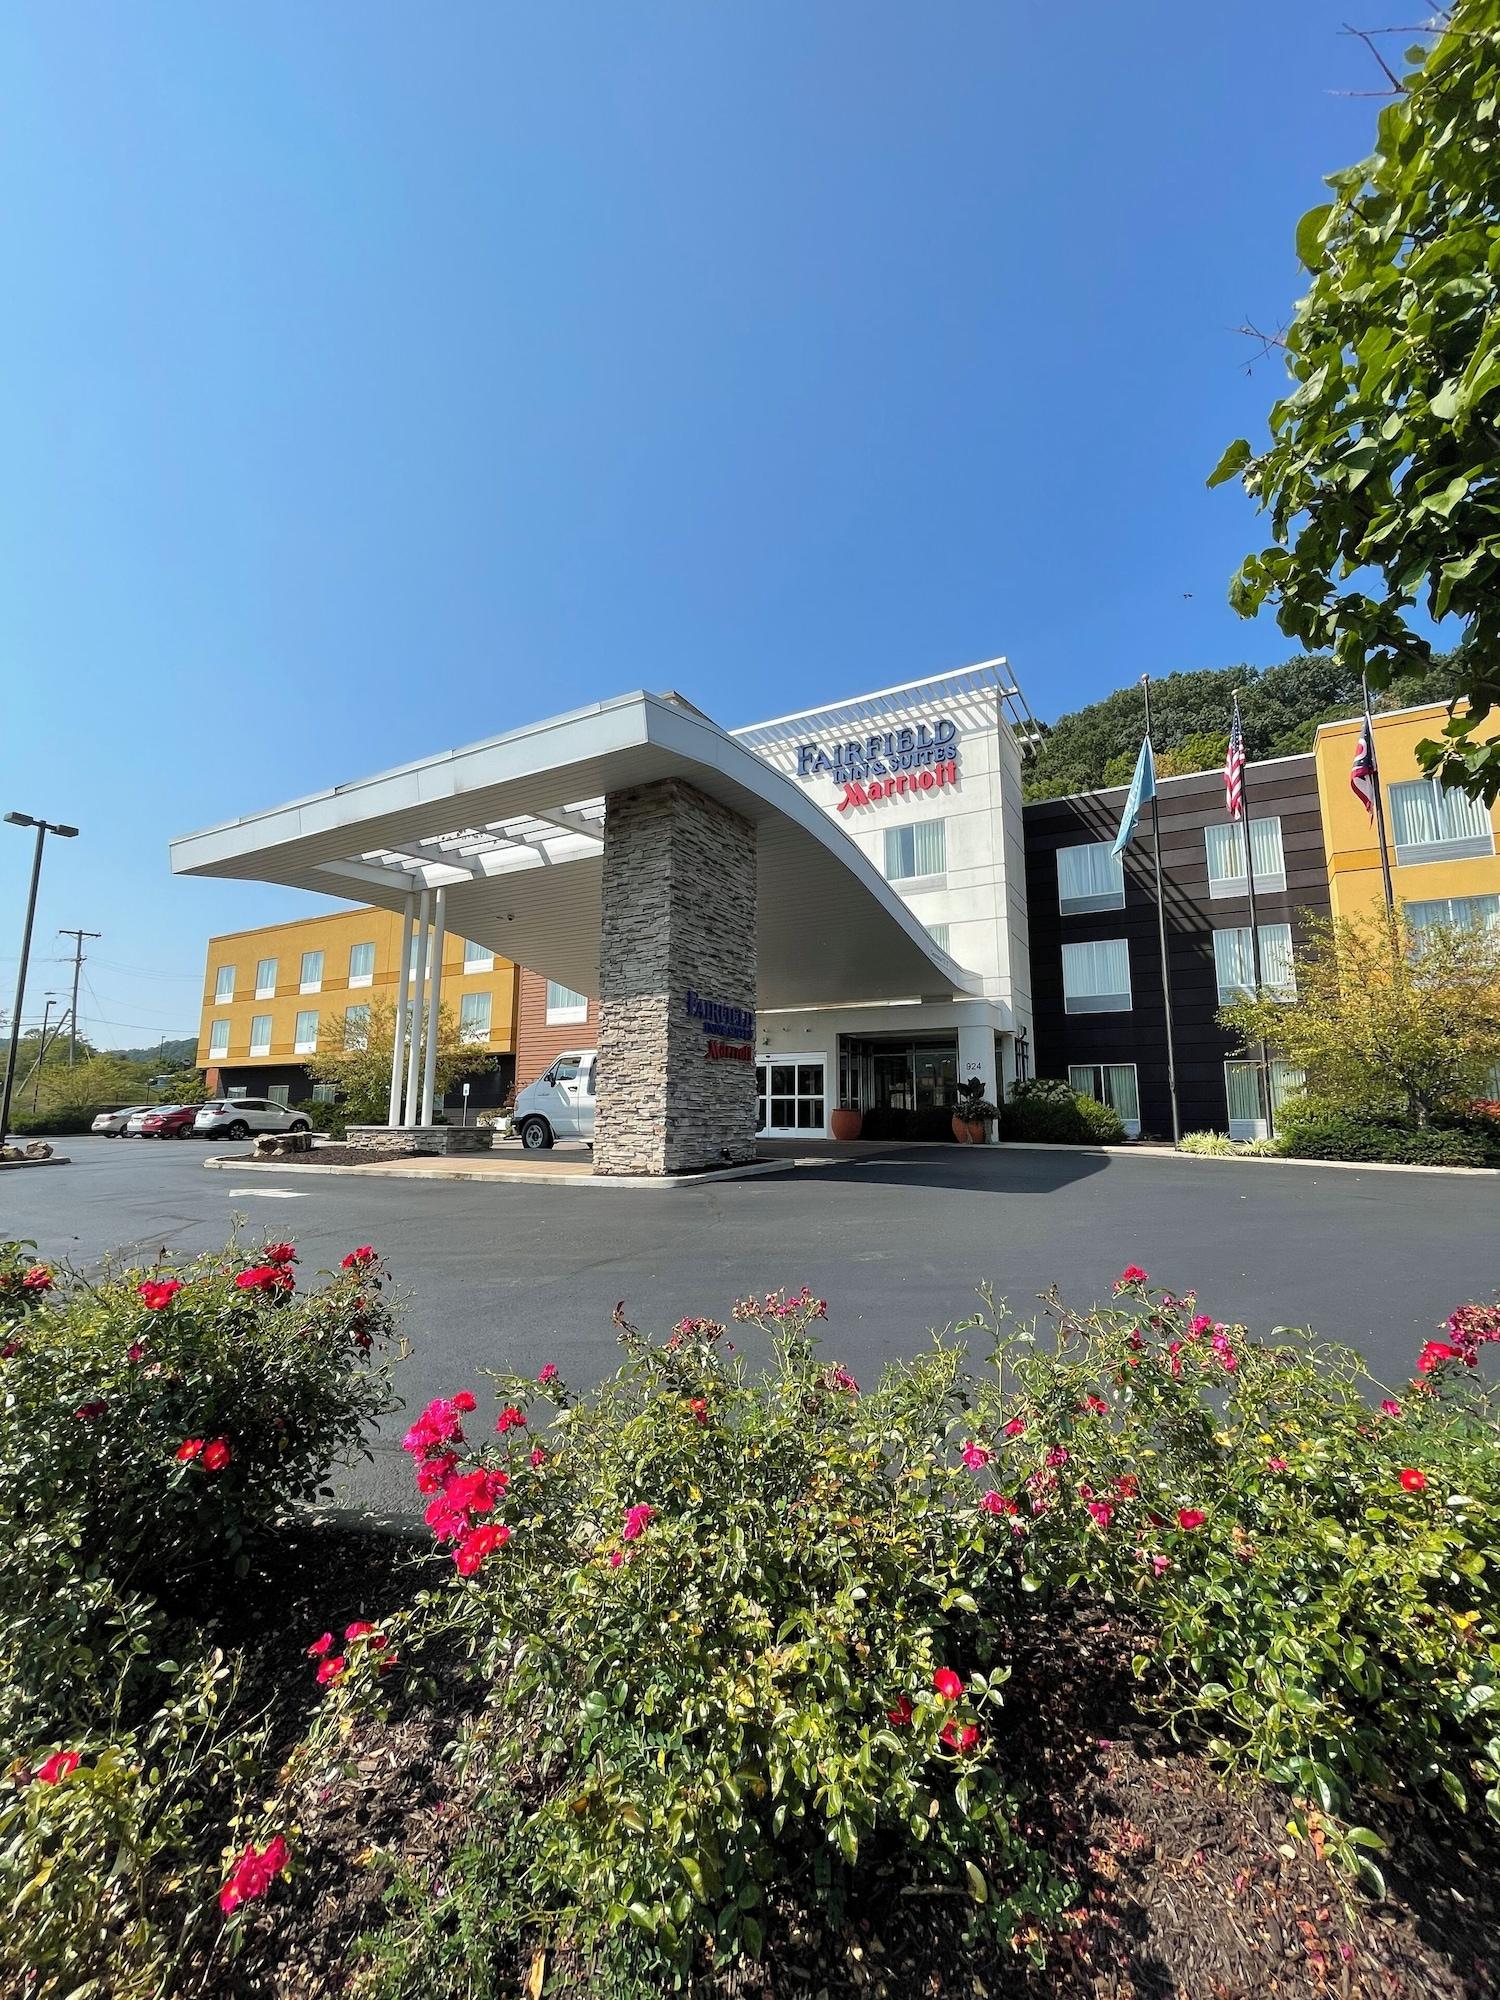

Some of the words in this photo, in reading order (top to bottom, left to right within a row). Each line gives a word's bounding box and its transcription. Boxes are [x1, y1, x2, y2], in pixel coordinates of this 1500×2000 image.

[795, 719, 957, 777] FAIRFIELD
[832, 763, 870, 784] INN
[871, 760, 887, 776] &
[888, 744, 957, 772] SUITES
[836, 761, 957, 812] Marriott
[967, 1062, 981, 1070] 924
